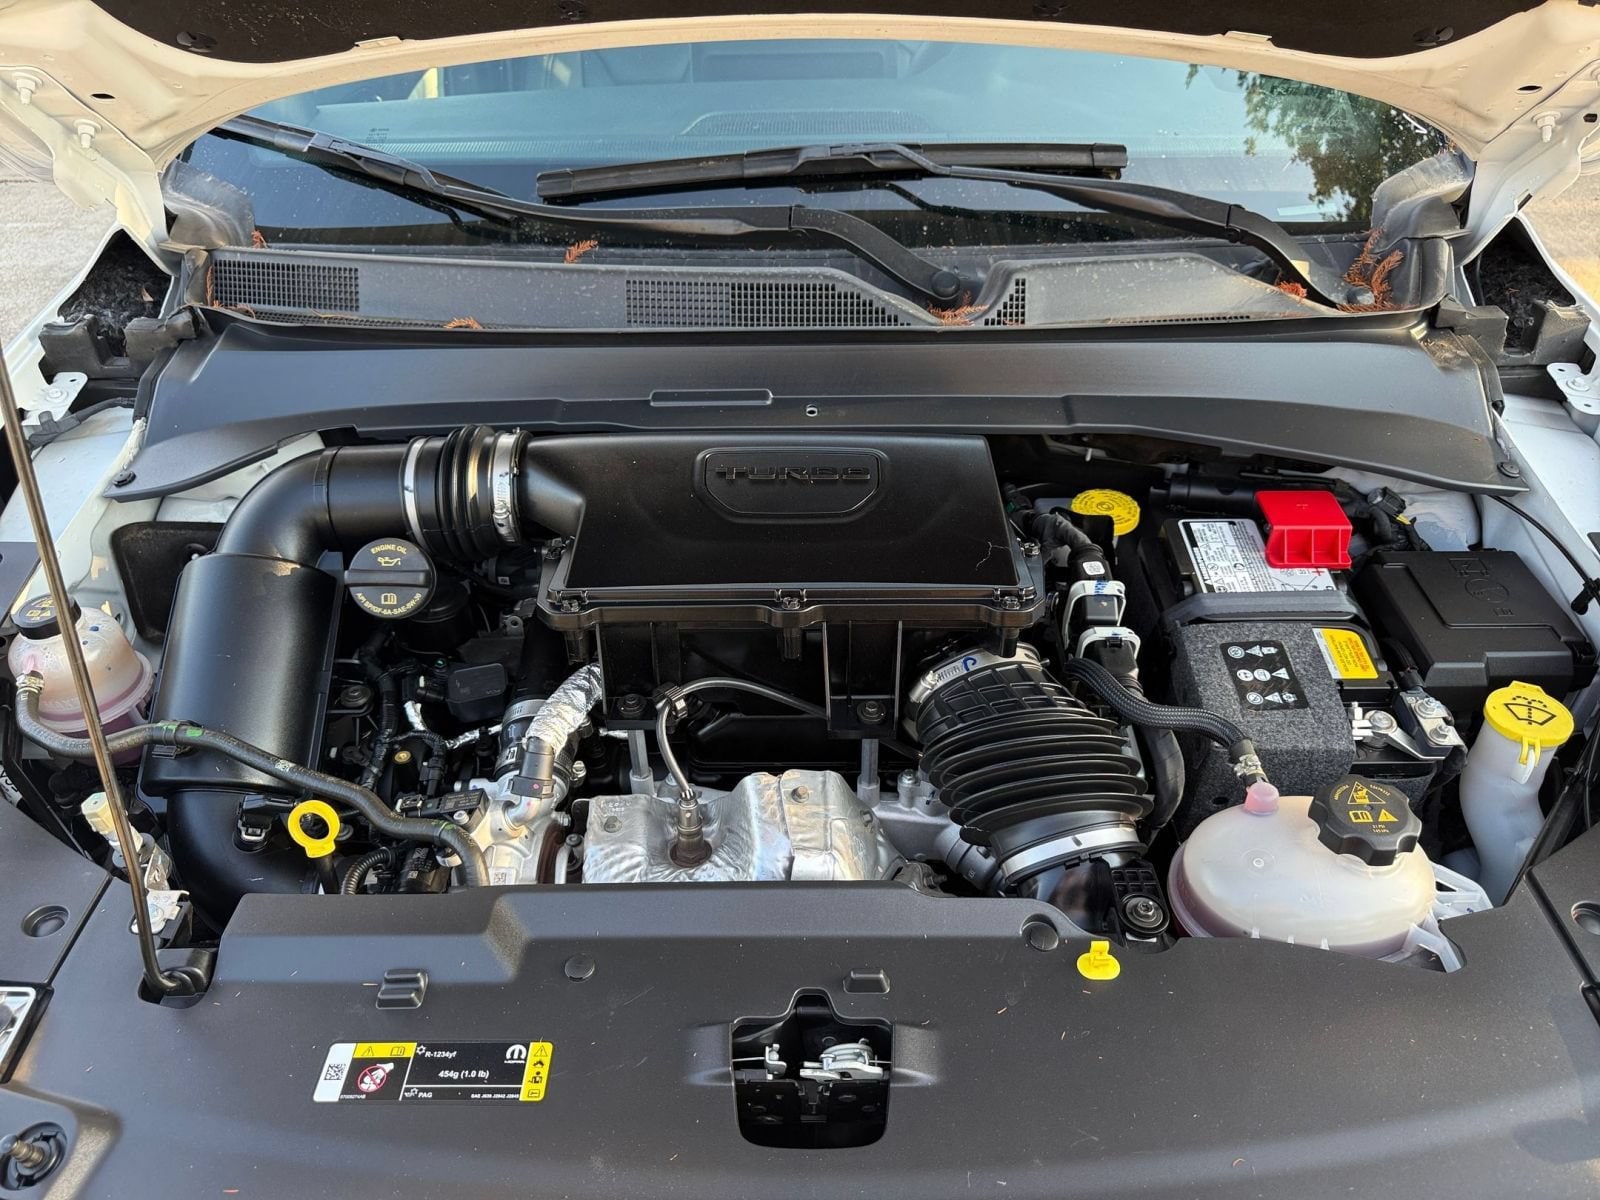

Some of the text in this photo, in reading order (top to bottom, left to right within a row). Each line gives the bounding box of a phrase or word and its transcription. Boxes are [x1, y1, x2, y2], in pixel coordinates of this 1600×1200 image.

[715, 467, 871, 481] TURBO
[370, 544, 408, 555] ENGINE OIL
[356, 592, 367, 604] API
[424, 1050, 457, 1059] R-1234yf
[438, 1070, 490, 1080] 454g (1.0 lb)
[417, 1091, 433, 1099] PAG
